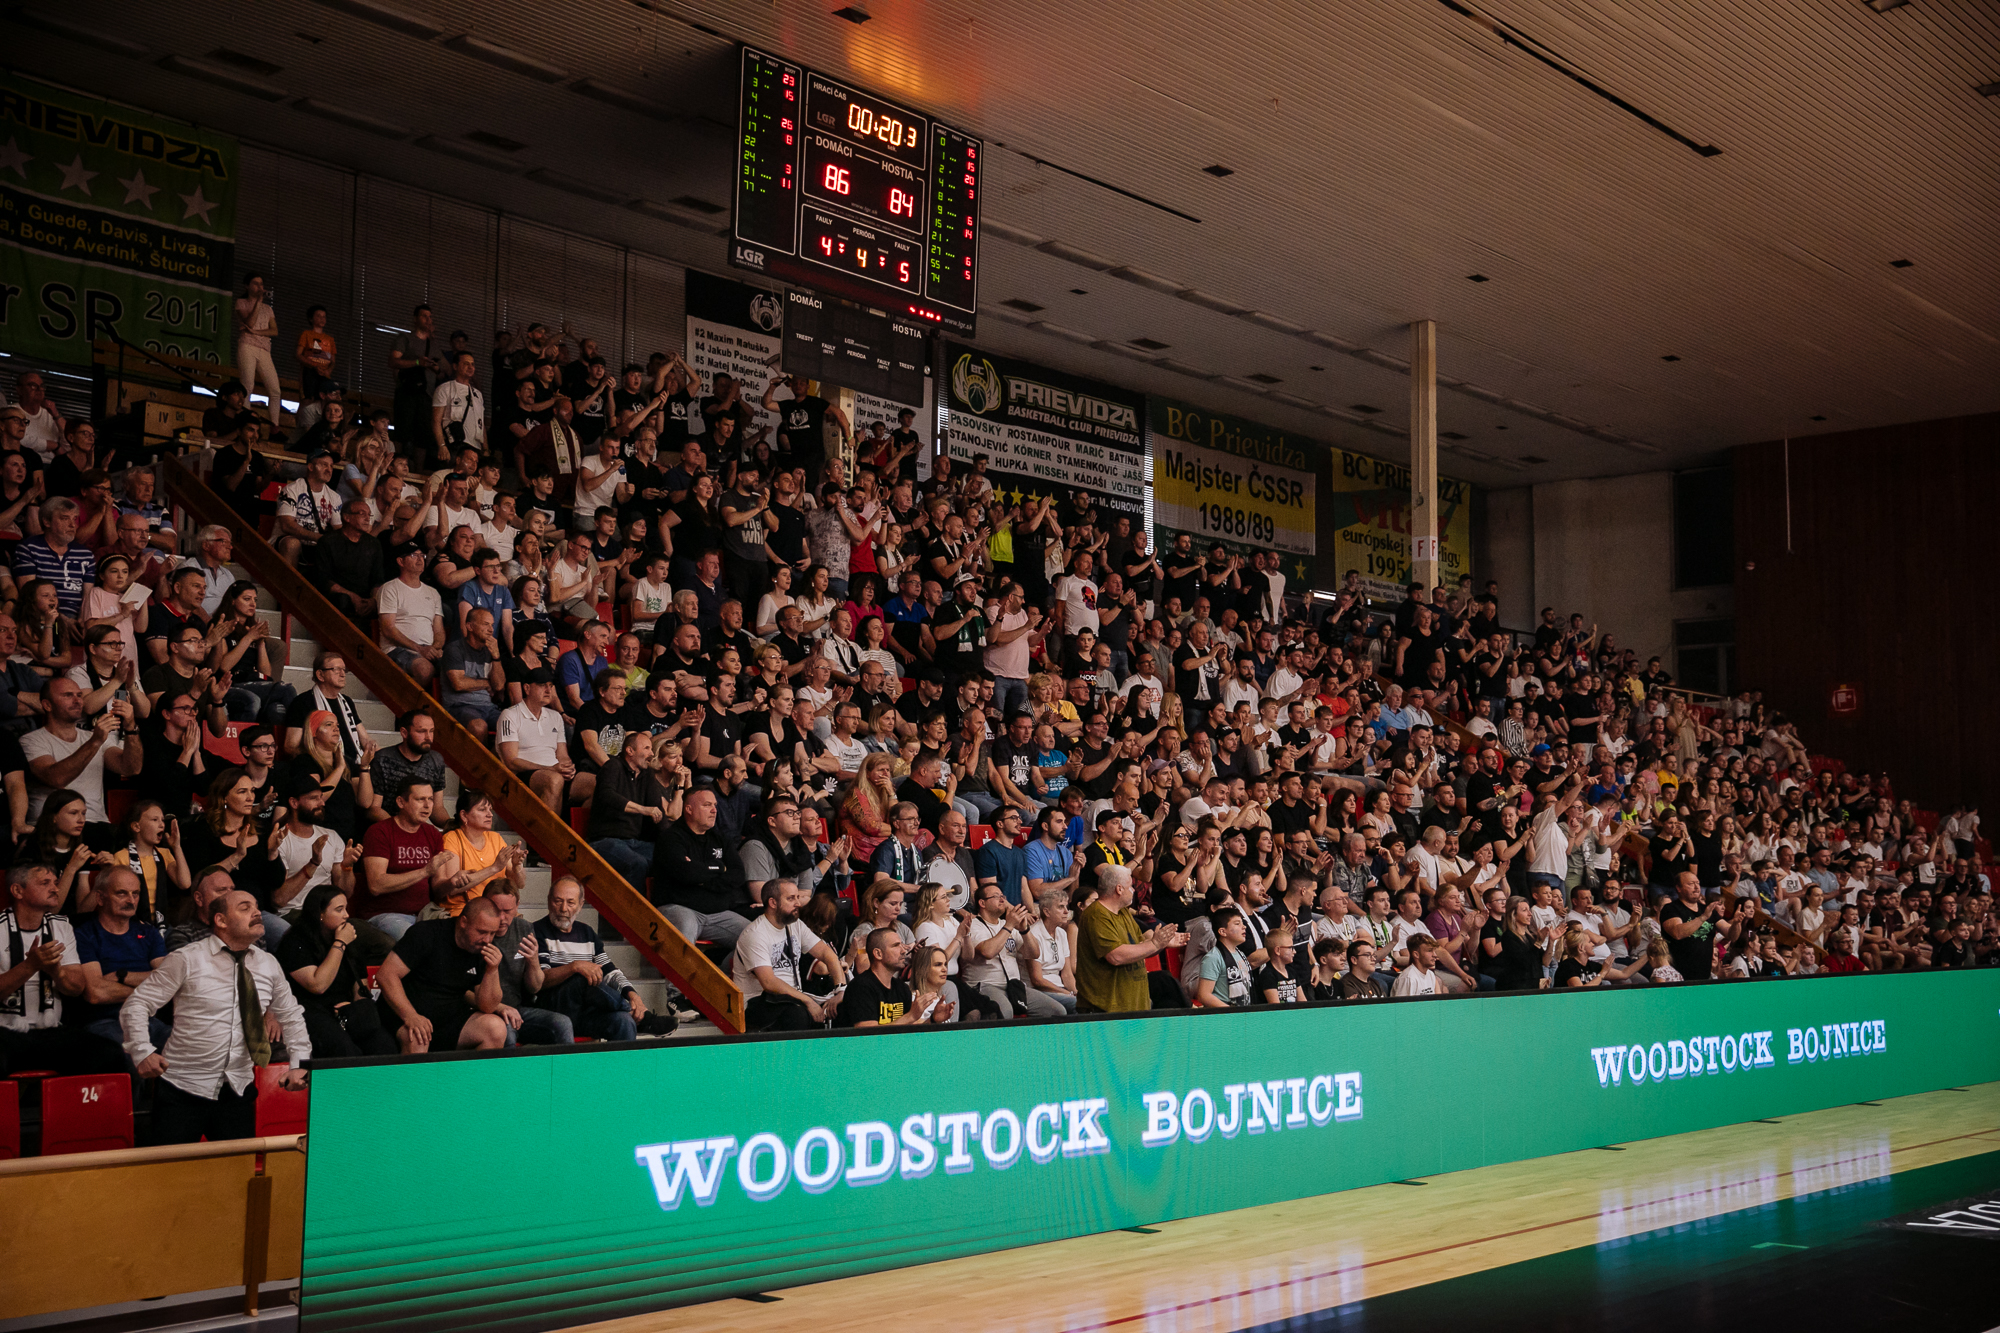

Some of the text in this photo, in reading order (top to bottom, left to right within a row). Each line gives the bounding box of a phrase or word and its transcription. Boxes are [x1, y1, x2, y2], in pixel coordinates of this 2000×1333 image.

[753, 77, 795, 101] 3 15
[782, 73, 795, 87] 23
[751, 91, 758, 102] 4
[749, 106, 757, 117] 11
[816, 111, 836, 126] LGR
[744, 135, 756, 147] 22
[748, 121, 793, 146] 17 8
[743, 150, 756, 162] 24
[816, 135, 914, 181] DOMÁCI HOSTIA
[968, 148, 976, 159] 15
[743, 163, 792, 177] 31 3
[939, 164, 975, 186] 2 20
[967, 161, 975, 173] 15
[743, 178, 791, 192] 77 11
[824, 163, 914, 218] 86 84
[938, 178, 975, 199] 4 3
[937, 205, 973, 226] 9 6
[28, 204, 92, 234] Guede,
[100, 219, 152, 248] Davis,
[161, 234, 210, 262] Livas,
[815, 214, 833, 226] FAULY
[852, 227, 876, 241] PERIÓDA
[894, 241, 911, 252] FAULY
[931, 230, 942, 242] 21
[935, 218, 973, 239] 15 14
[20, 221, 67, 251] Boor,
[73, 236, 144, 267] Averink,
[149, 249, 210, 279] Šturcel
[736, 246, 765, 266] LGR
[821, 236, 910, 283] 4 4 5
[930, 244, 971, 267] 27 6
[930, 258, 971, 281] 55 5
[931, 272, 940, 283] 74
[39, 281, 124, 343] SR
[144, 291, 218, 333] 2011
[790, 293, 922, 339] DOMÁCI HOSTIA
[707, 330, 734, 345] Maxim
[736, 337, 770, 354] Matuška
[796, 333, 814, 342] TRESTY
[707, 344, 732, 357] Jakub
[707, 357, 730, 373] Matej
[856, 394, 881, 407] Delvon
[1008, 378, 1138, 431] PRIEVIDZA
[856, 407, 884, 421] Ibrahim
[1008, 405, 1140, 446] BASKETBALL CLUB PRIEVIDZA
[951, 413, 1139, 467] PASOVSKÝ ROSTAMPOUR MARIĆ BATINA
[1166, 406, 1306, 470] BC Prievidza
[950, 429, 1008, 452] STANOJEVIĆ
[1014, 443, 1051, 461] KÖRNER
[1057, 454, 1118, 476] STAMENKOVIĆ
[995, 457, 1144, 496] HUPKA WISSEH KÁDAŠI VOJTEK
[1342, 452, 1368, 480] BC
[1165, 449, 1304, 508] Majster ČSSR
[1199, 502, 1274, 543] 1988/89
[1342, 529, 1404, 558] európskej
[1417, 540, 1424, 557] F
[1431, 540, 1436, 557] F
[1367, 553, 1406, 582] 1995
[357, 645, 364, 660] 6
[226, 727, 237, 739] 29
[501, 781, 509, 798] 4
[398, 846, 430, 860] BOSS
[568, 845, 577, 862] 3
[650, 922, 659, 941] 2
[727, 994, 732, 1013] 1
[1591, 1019, 1887, 1087] WOODSTOCK BOJNICE
[81, 1086, 98, 1104] 24
[636, 1072, 1363, 1210] WOODSTOCK BOJNICE
